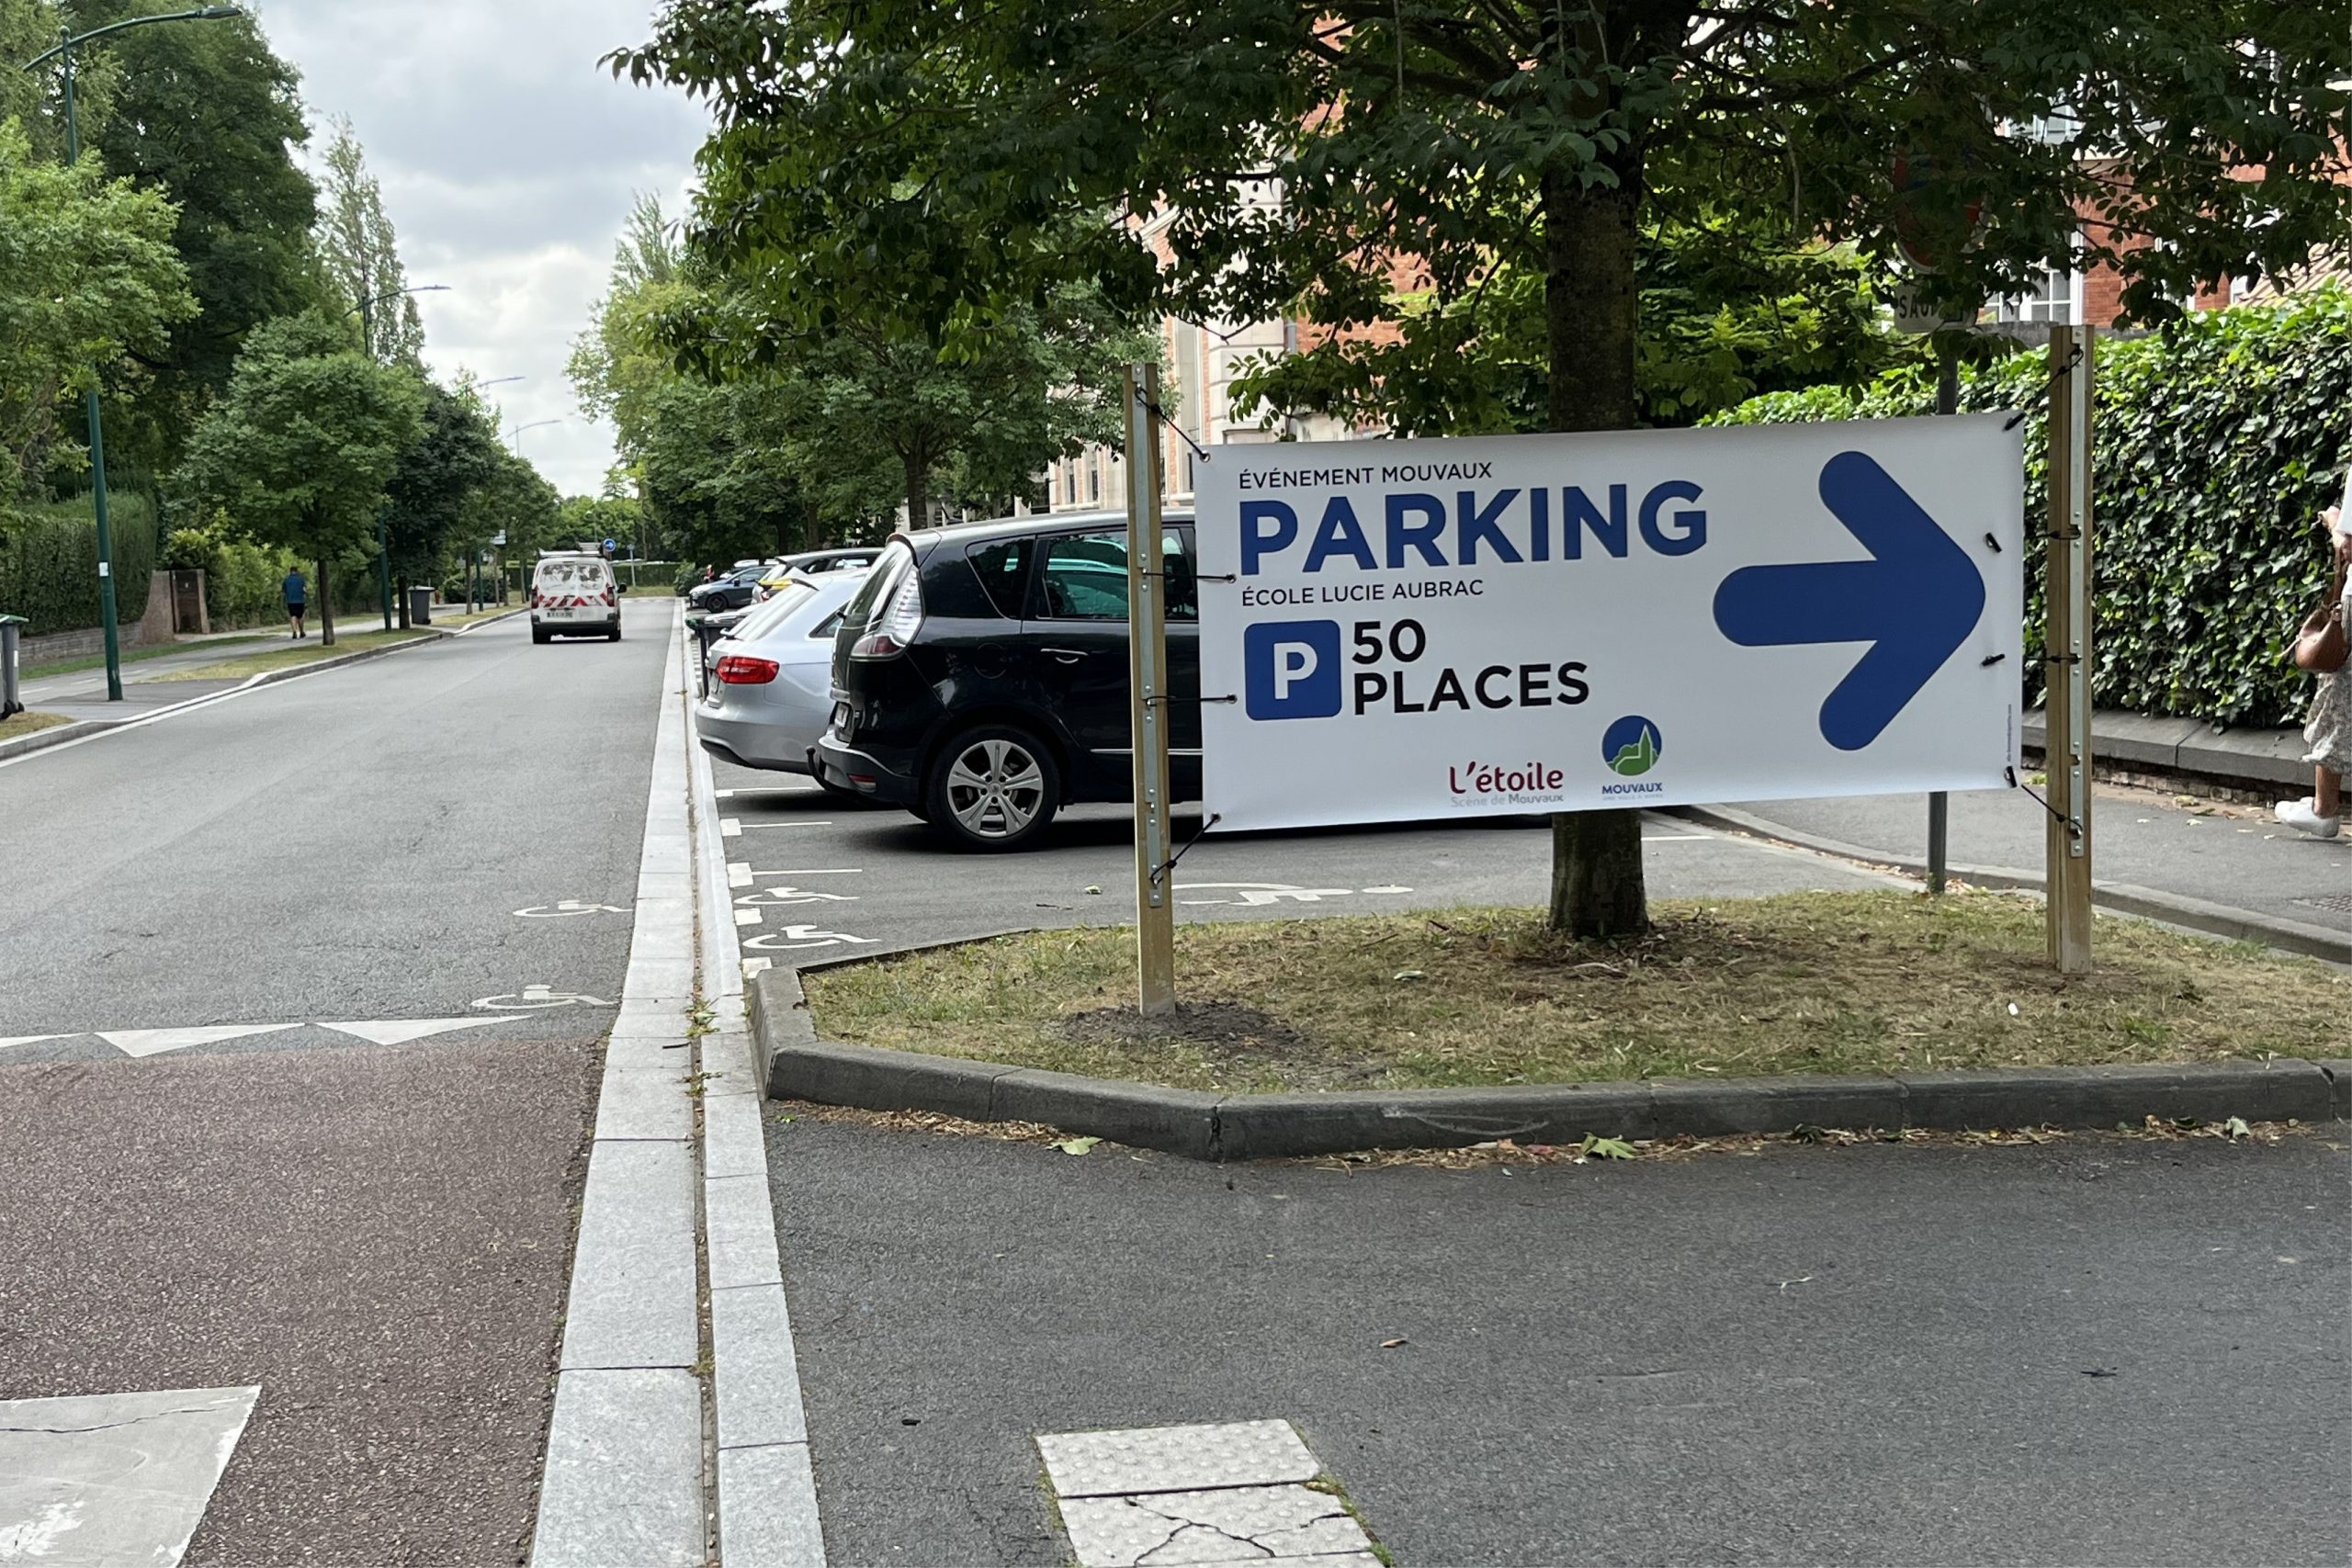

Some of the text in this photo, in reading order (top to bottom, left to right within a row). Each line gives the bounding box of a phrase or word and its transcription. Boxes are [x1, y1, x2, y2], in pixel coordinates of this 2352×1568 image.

[1239, 461, 1492, 490] ÉVÉNEMENT MOUVAUX
[1239, 479, 1707, 576] PARKING
[1242, 580, 1484, 606] ÉCOLE LUCIE AUBRAC
[1351, 618, 1426, 665] 50
[1273, 641, 1317, 700] P
[1354, 661, 1589, 716] PLACES
[1449, 761, 1564, 794] L'étoile
[1601, 782, 1663, 795] MOUVAUX
[1451, 793, 1564, 808] Scène de Mouvaux
